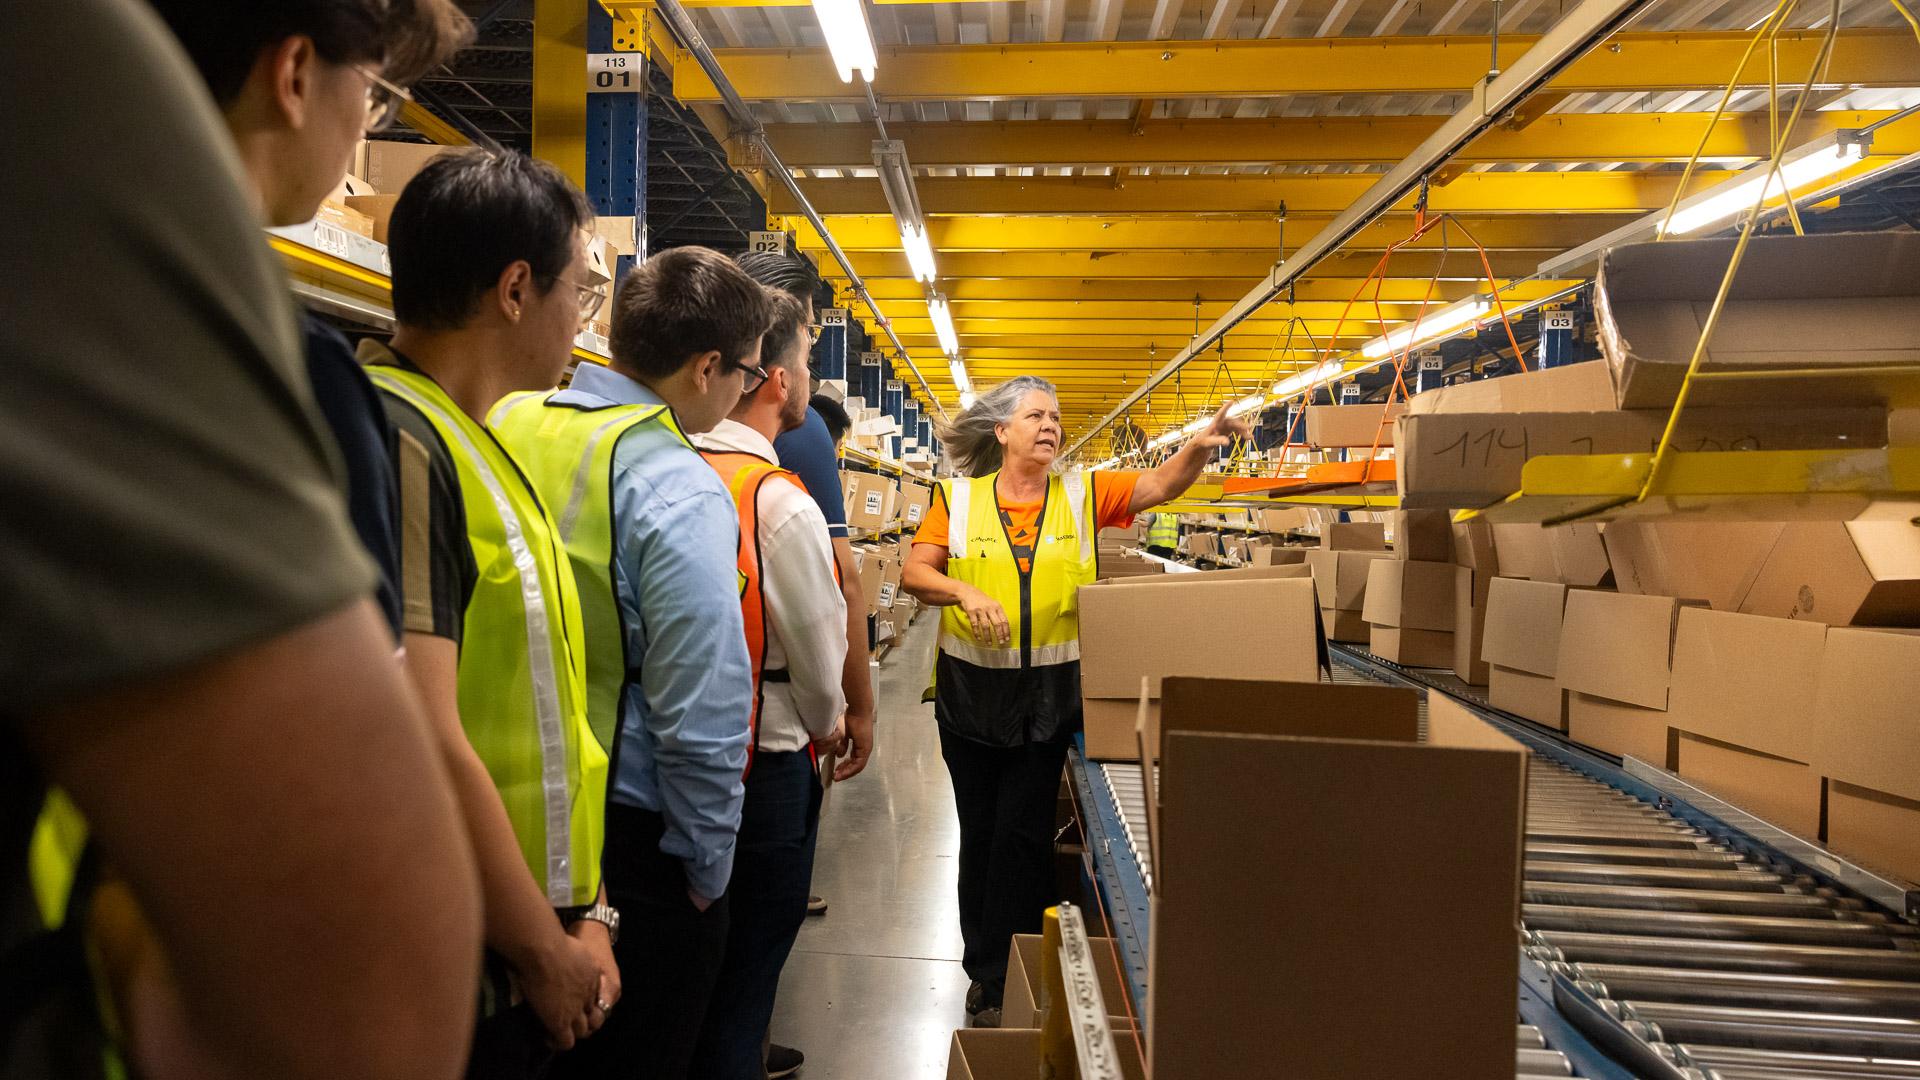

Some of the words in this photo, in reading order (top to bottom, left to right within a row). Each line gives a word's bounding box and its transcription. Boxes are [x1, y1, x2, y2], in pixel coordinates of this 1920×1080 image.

[604, 57, 626, 68] 113
[596, 71, 630, 87] 01
[760, 233, 775, 241] 113
[755, 241, 779, 252] 02
[825, 315, 843, 324] 03
[1551, 318, 1570, 327] 03
[865, 357, 878, 365] 04
[1424, 361, 1439, 369] 04
[1433, 427, 1529, 468] 114
